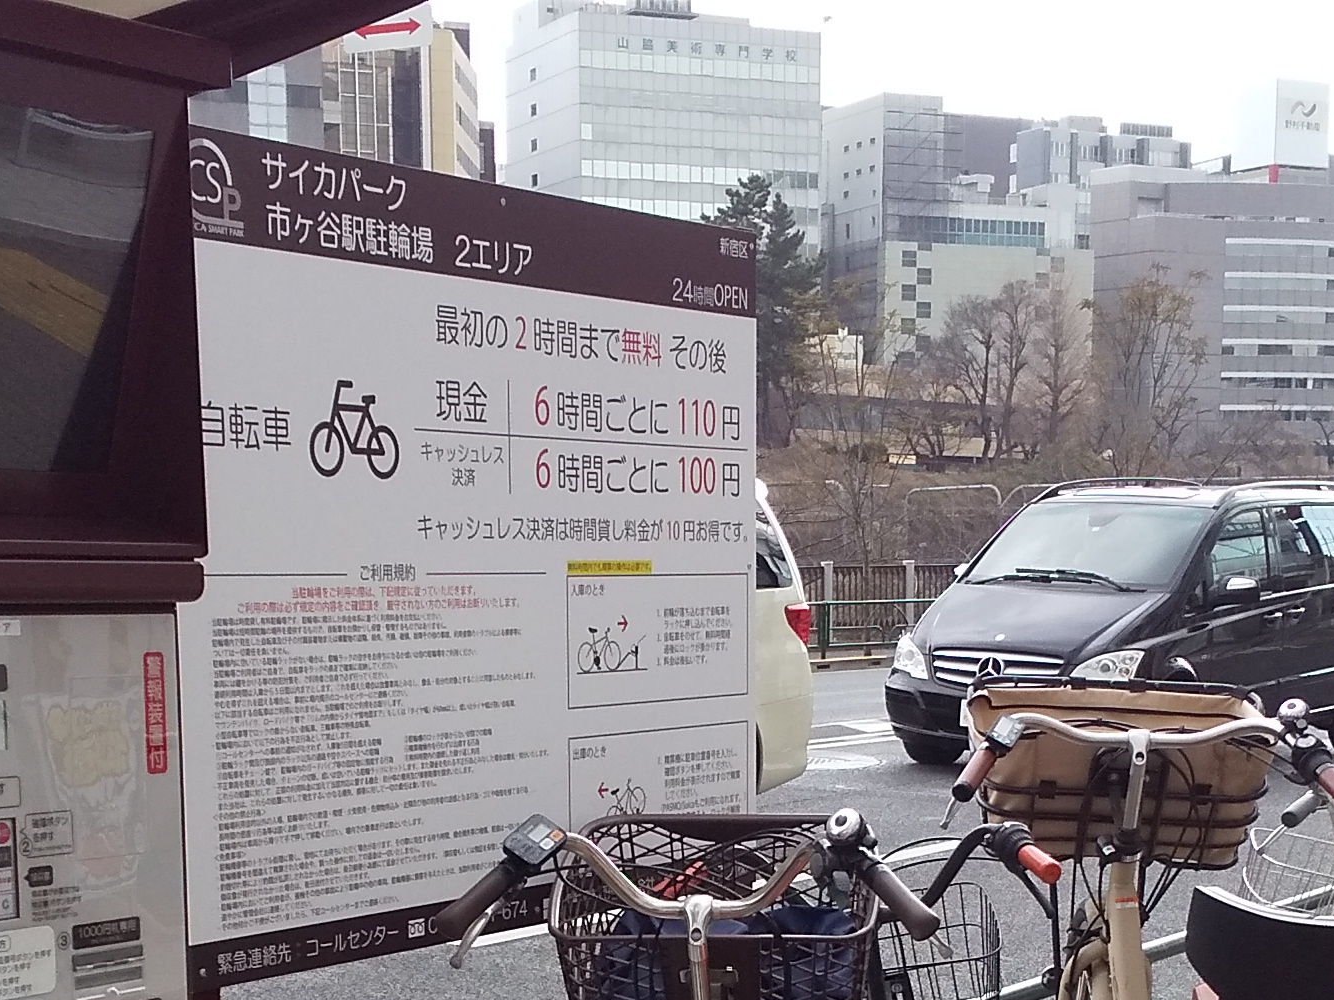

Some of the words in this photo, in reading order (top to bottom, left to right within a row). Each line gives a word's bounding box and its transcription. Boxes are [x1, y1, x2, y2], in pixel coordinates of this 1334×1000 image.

[617, 36, 797, 62] 山脇美術専門学校
[261, 152, 406, 211] サイカパーク
[266, 201, 434, 264] 市ヶ谷駅駐輪場
[454, 235, 534, 278] 2エリア
[719, 236, 748, 259] 新宿区
[672, 277, 748, 311] 24時間OPEN
[436, 380, 487, 424] 現金
[201, 402, 291, 452] 自転車
[420, 441, 504, 465] キャッシュレス
[452, 467, 476, 487] 決済
[360, 563, 416, 582] ご利用規約
[571, 583, 605, 597] 入庫のとき
[572, 746, 607, 761] 出庫のとき
